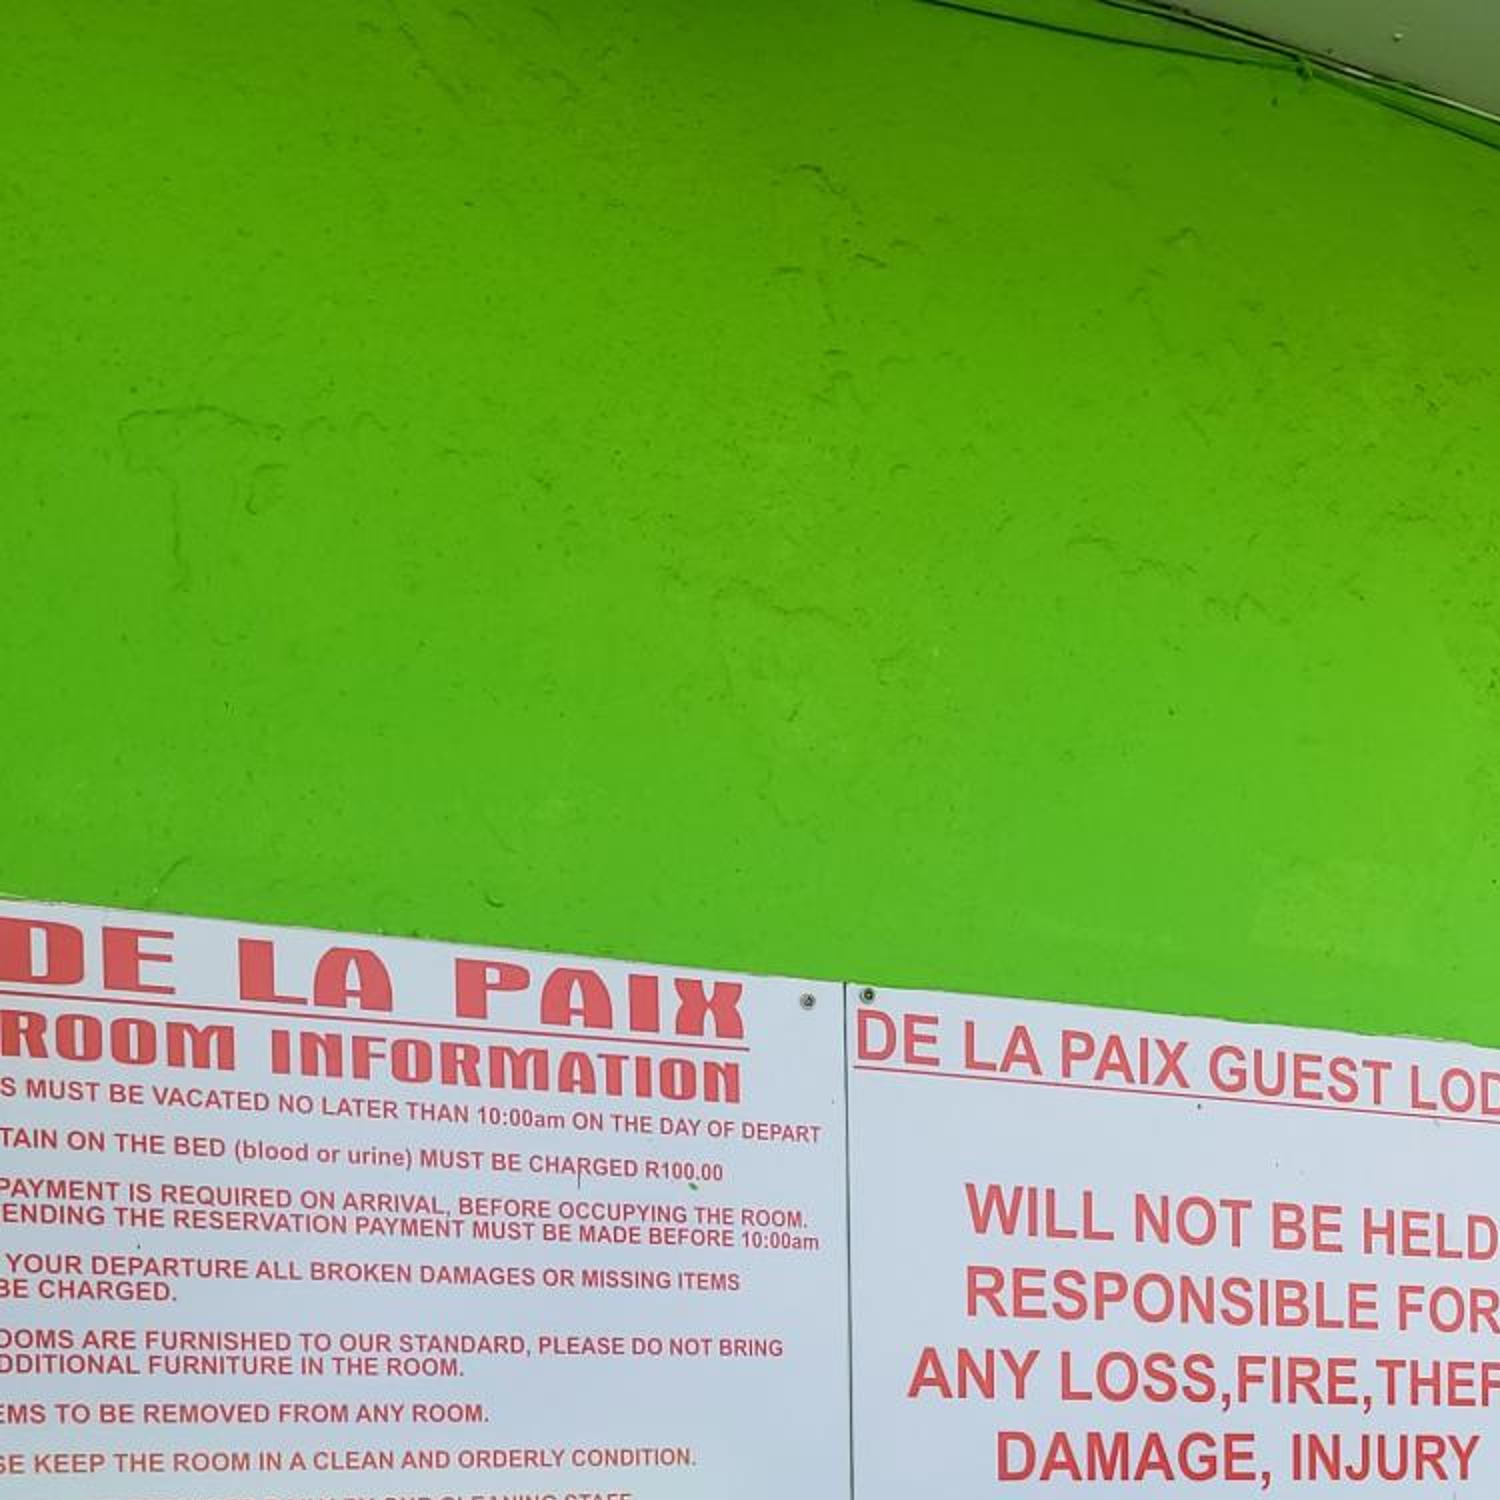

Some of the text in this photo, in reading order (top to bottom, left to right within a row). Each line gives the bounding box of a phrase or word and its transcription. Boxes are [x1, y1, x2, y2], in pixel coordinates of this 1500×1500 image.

[0, 915, 745, 1041] DE LA PAIX
[0, 1008, 742, 1105] ROOM INFORMATION
[855, 1007, 942, 1068] DE
[963, 1019, 1044, 1077] LA
[1060, 1028, 1192, 1090] PAIX
[1208, 1043, 1394, 1107] GUEST
[25, 1076, 822, 1145] MUST BE VACATED NO LATER THAN 10:00am ON THE DAY OF DEPART
[65, 1129, 724, 1185] ON THE BED (blood or urine) MUST BE CHARGED R100.00
[128, 1182, 153, 1204] IS
[160, 1182, 293, 1209] REQUIRED
[299, 1189, 336, 1212] ON
[341, 1190, 452, 1219] ARRIVAL,
[458, 1196, 553, 1220] BEFORE
[557, 1200, 688, 1227] OCCUPYING
[692, 1205, 736, 1227] THE
[740, 1207, 809, 1230] ROOM.
[964, 1181, 1500, 1262] WILL NOT BE HELD
[4, 1251, 741, 1292] YOUR DEPARTURE ALL BROKEN DAMAGES OR MISSING ITEMS
[966, 1264, 1380, 1331] RESPONSIBLE
[906, 1346, 1042, 1401] ANY
[53, 1402, 490, 1425] TO BE REMOVED FROM ANY ROOM.
[32, 1446, 696, 1475] KEEP THE ROOM IN A CLEAN AND ORDERLY CONDITION.
[996, 1429, 1482, 1492] DAMAGE, INJURY
